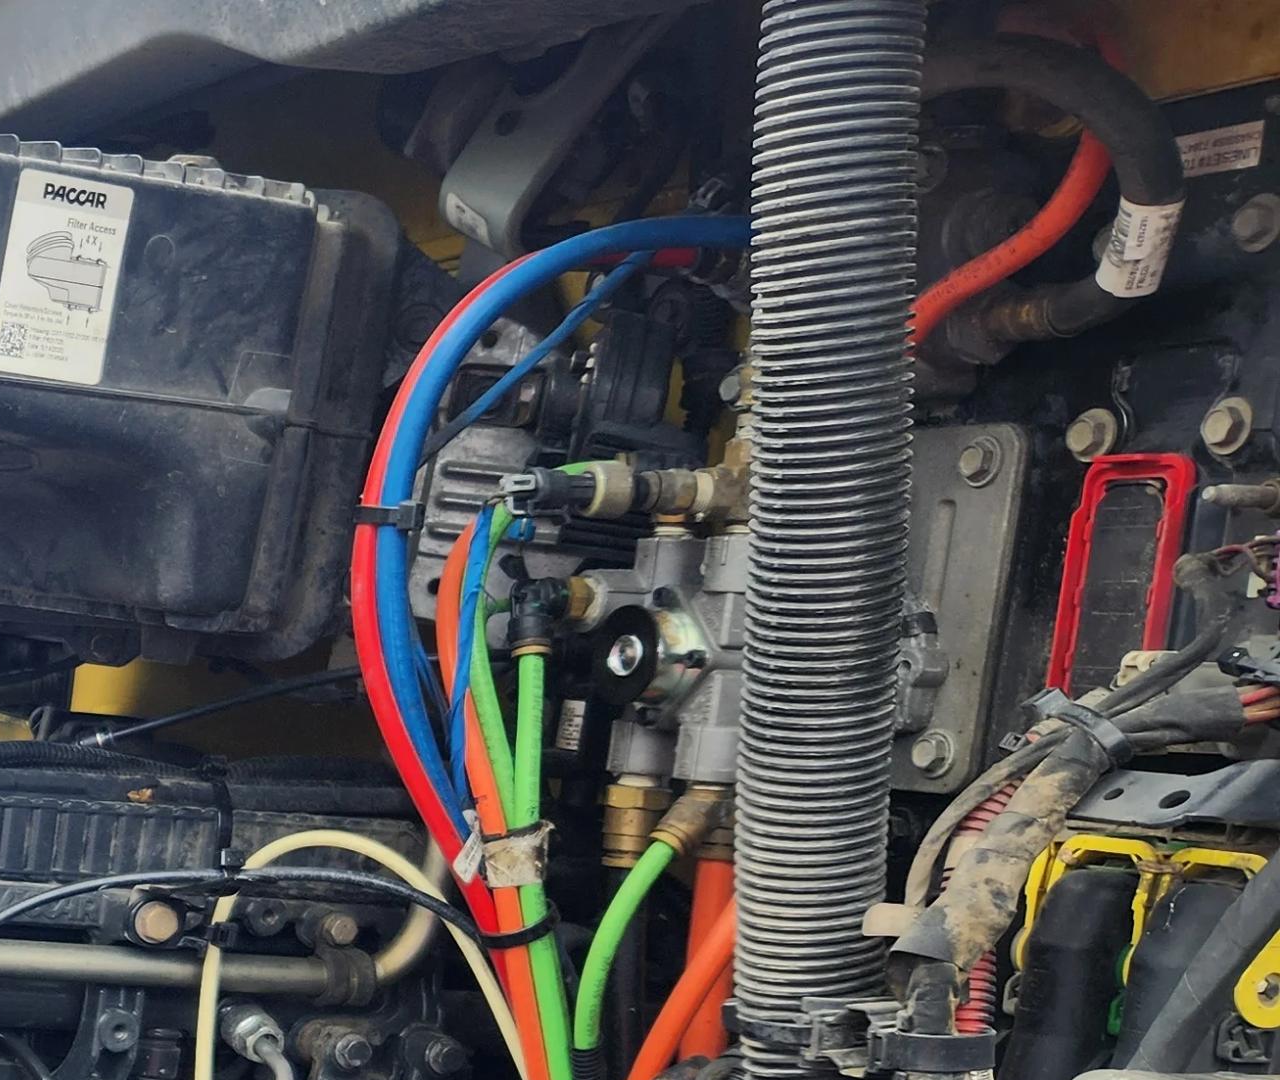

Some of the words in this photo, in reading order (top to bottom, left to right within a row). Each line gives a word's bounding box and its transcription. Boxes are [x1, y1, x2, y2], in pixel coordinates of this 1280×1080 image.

[43, 182, 108, 209] PACCAR
[67, 217, 87, 231] Filter
[89, 221, 117, 236] Access
